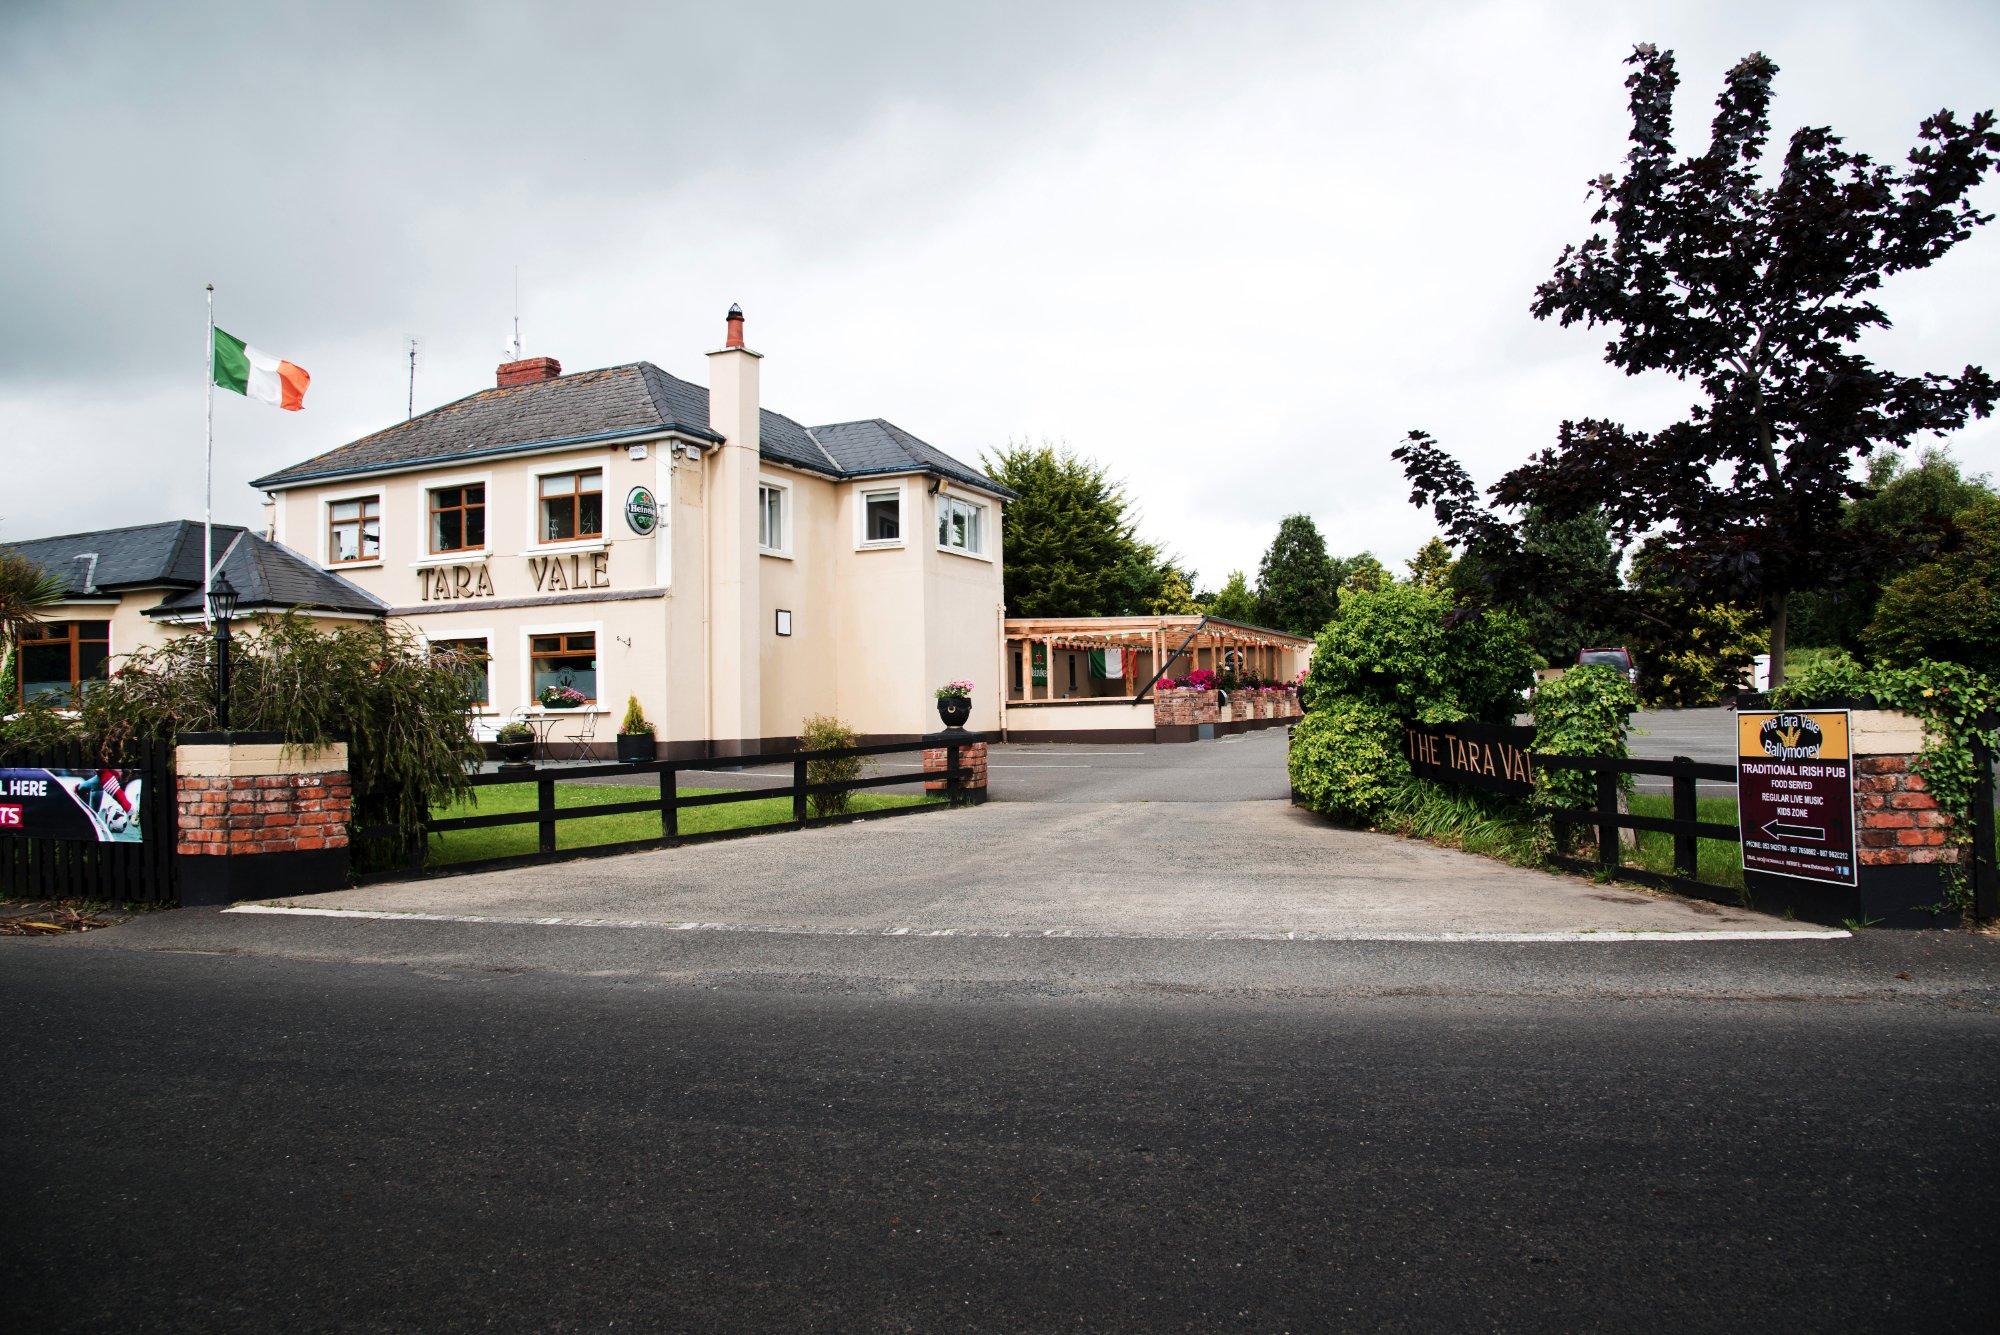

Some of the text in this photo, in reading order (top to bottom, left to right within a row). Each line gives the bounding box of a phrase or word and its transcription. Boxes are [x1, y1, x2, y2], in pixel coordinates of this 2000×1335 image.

[416, 552, 610, 601] TARA VALE
[1760, 713, 1820, 734] The Tara Vale
[1406, 728, 1536, 785] THE TARA VAL
[1764, 739, 1820, 761] Ballymoney
[1742, 763, 1846, 778] TRADITIONAL IRISH PUB
[10, 781, 48, 796] HERE
[1771, 779, 1813, 790] FOOD SERVED
[1761, 792, 1824, 805] REGULAR LIVE MUSIC
[0, 807, 20, 824] TS
[1776, 807, 1808, 818] KIDS ZONE
